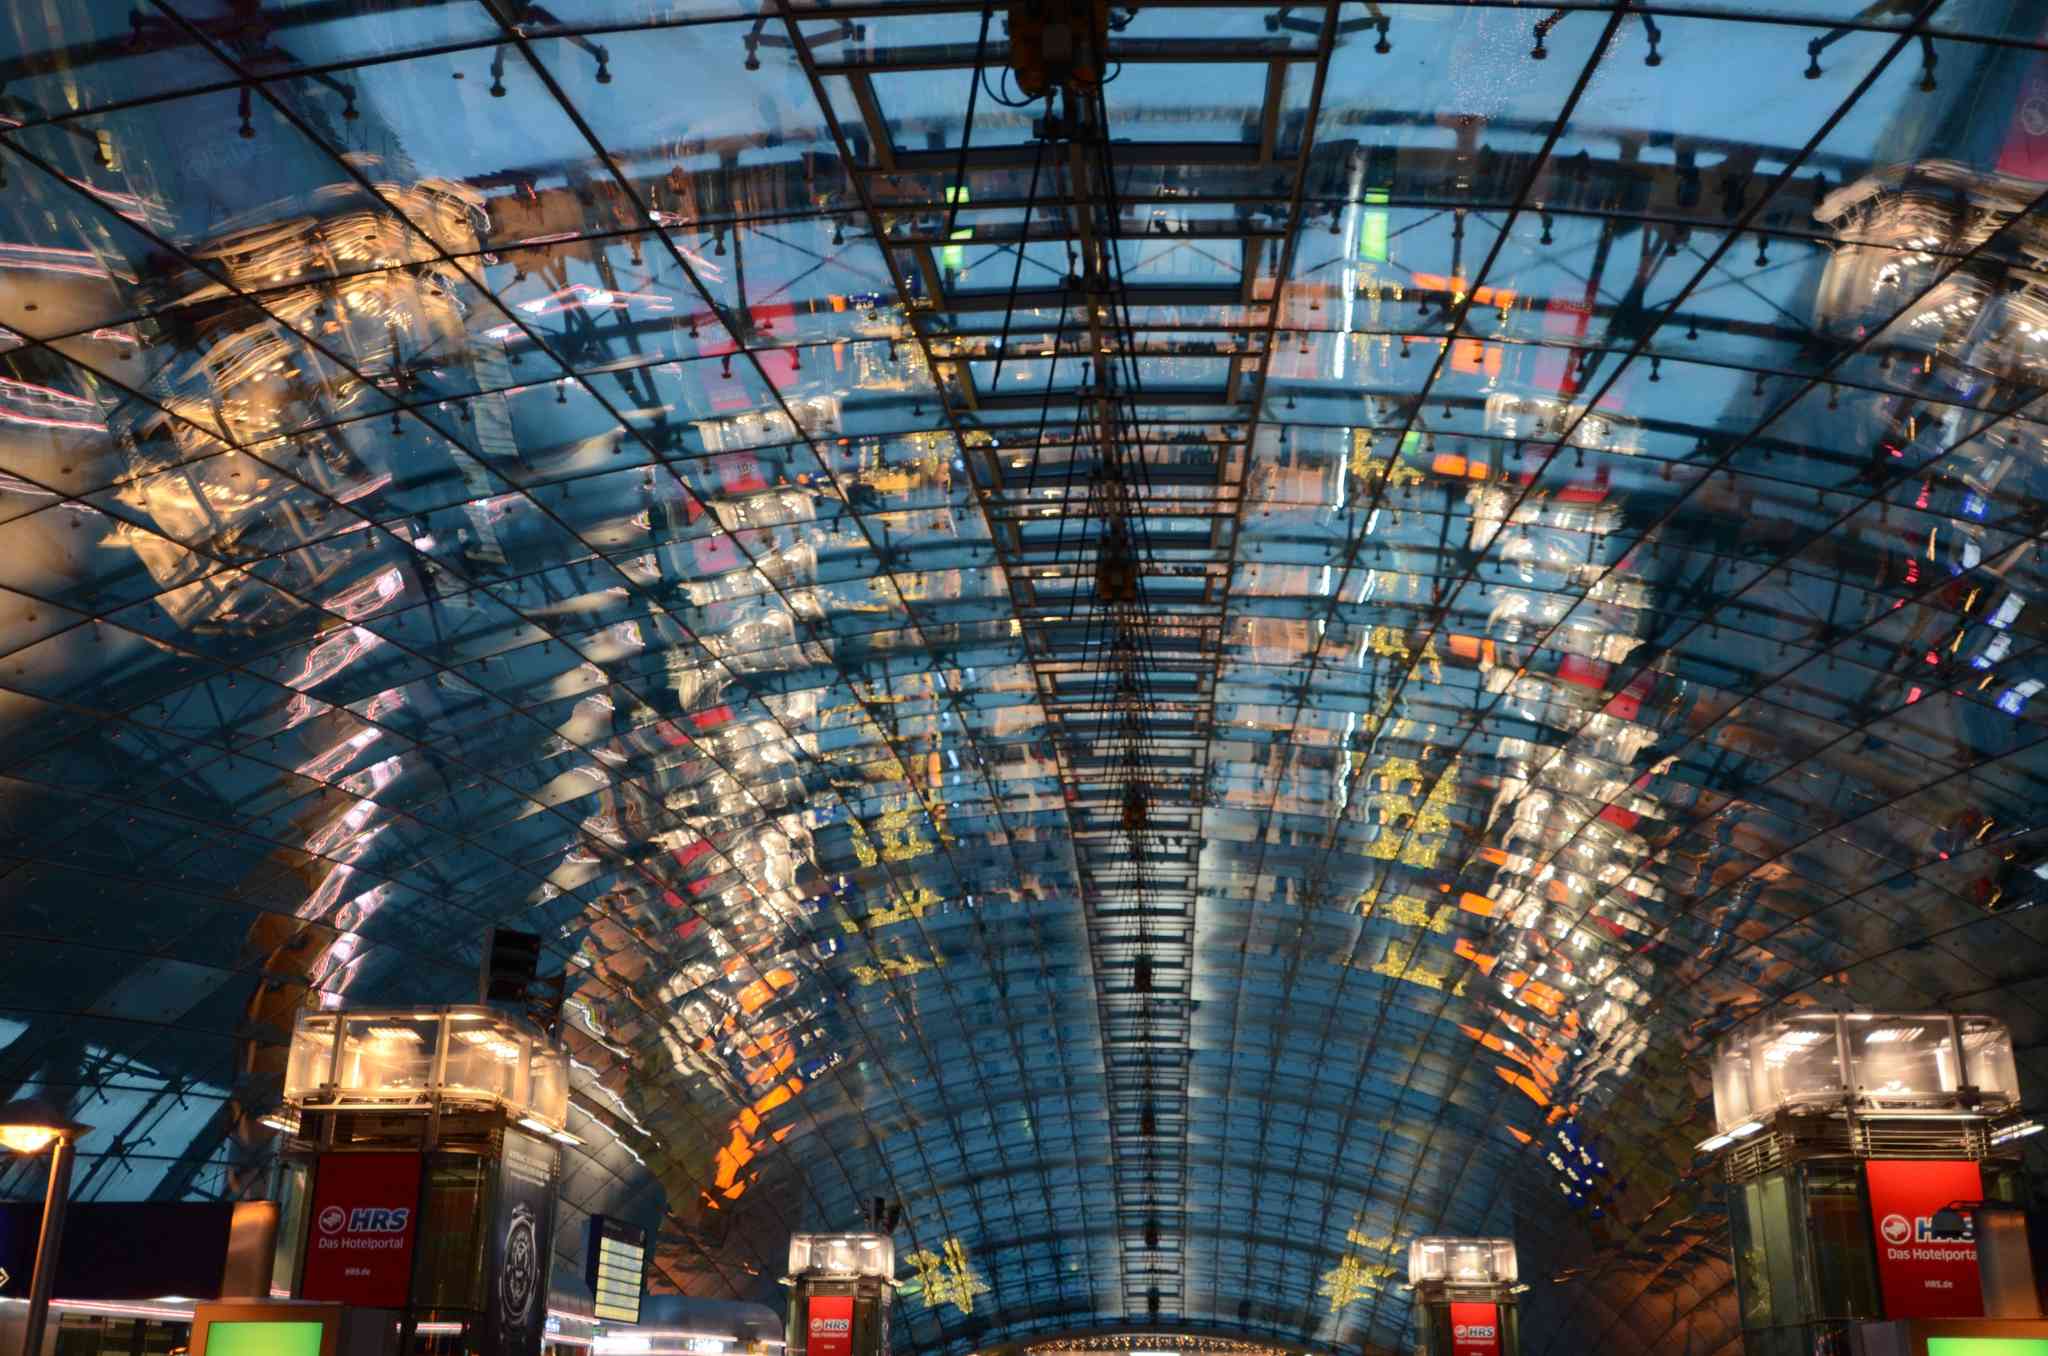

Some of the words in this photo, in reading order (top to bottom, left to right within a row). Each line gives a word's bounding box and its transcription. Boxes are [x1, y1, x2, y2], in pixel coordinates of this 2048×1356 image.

[347, 1207, 410, 1233] HRS
[318, 1239, 338, 1249] Das
[341, 1238, 404, 1251] Hotelportal
[1888, 1248, 1911, 1260] Das
[823, 1318, 849, 1331] HRS
[1468, 1326, 1495, 1338] HRS
